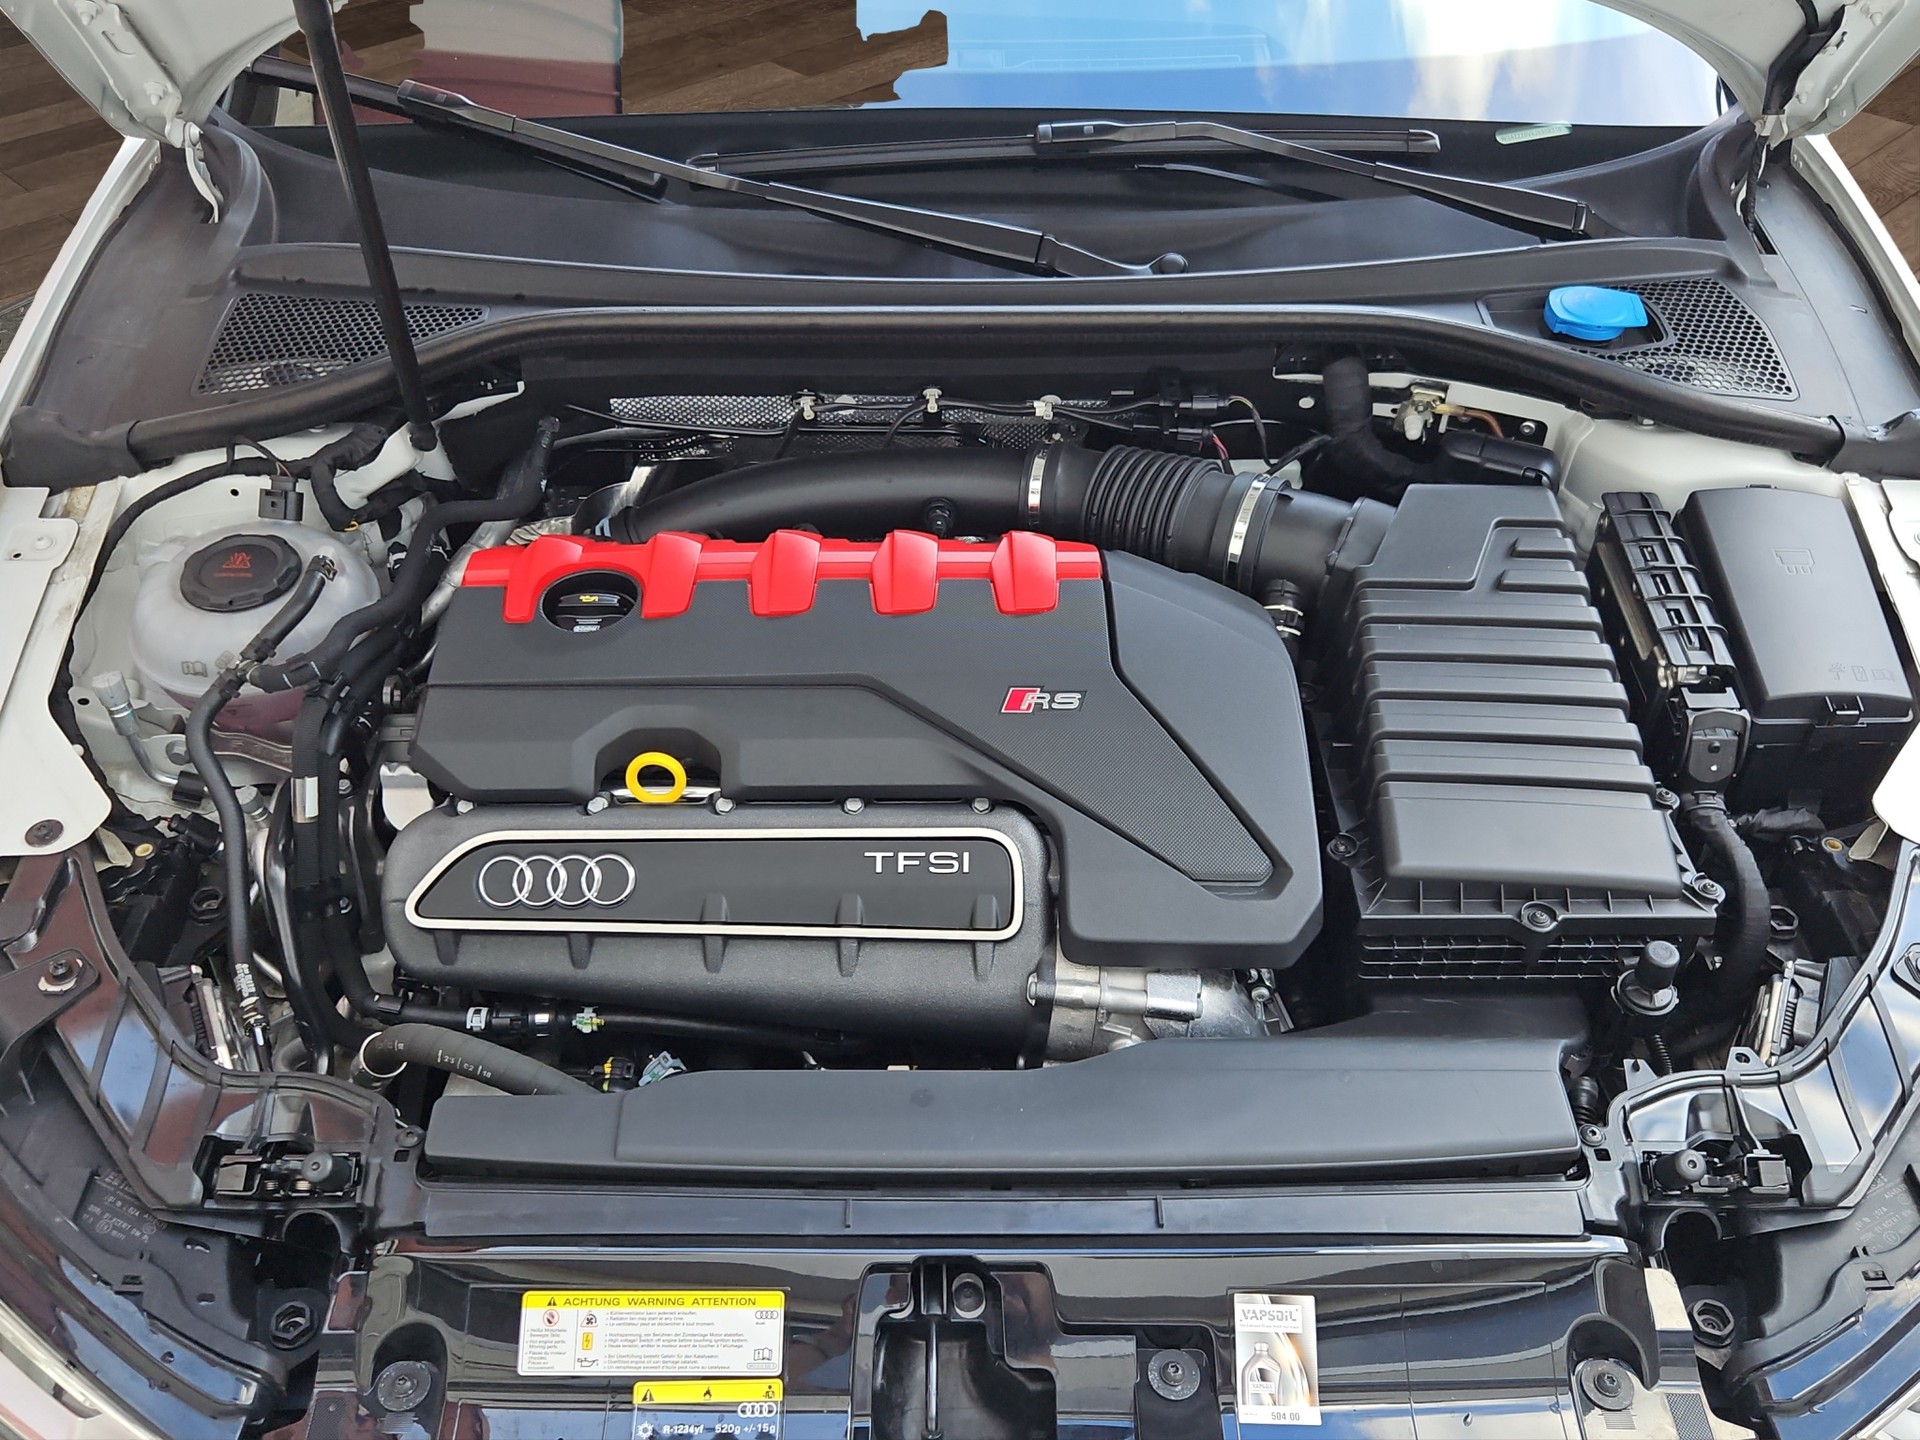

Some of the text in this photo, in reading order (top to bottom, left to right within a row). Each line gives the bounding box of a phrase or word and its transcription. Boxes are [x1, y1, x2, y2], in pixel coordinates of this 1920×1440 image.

[1018, 691, 1082, 710] RS
[864, 851, 970, 874] TFSI
[563, 1297, 756, 1306] ACHTUNG WARNING ATTENTION
[1272, 1412, 1286, 1420] 504
[662, 1424, 705, 1434] R-1234yf
[715, 1424, 741, 1434] 520g
